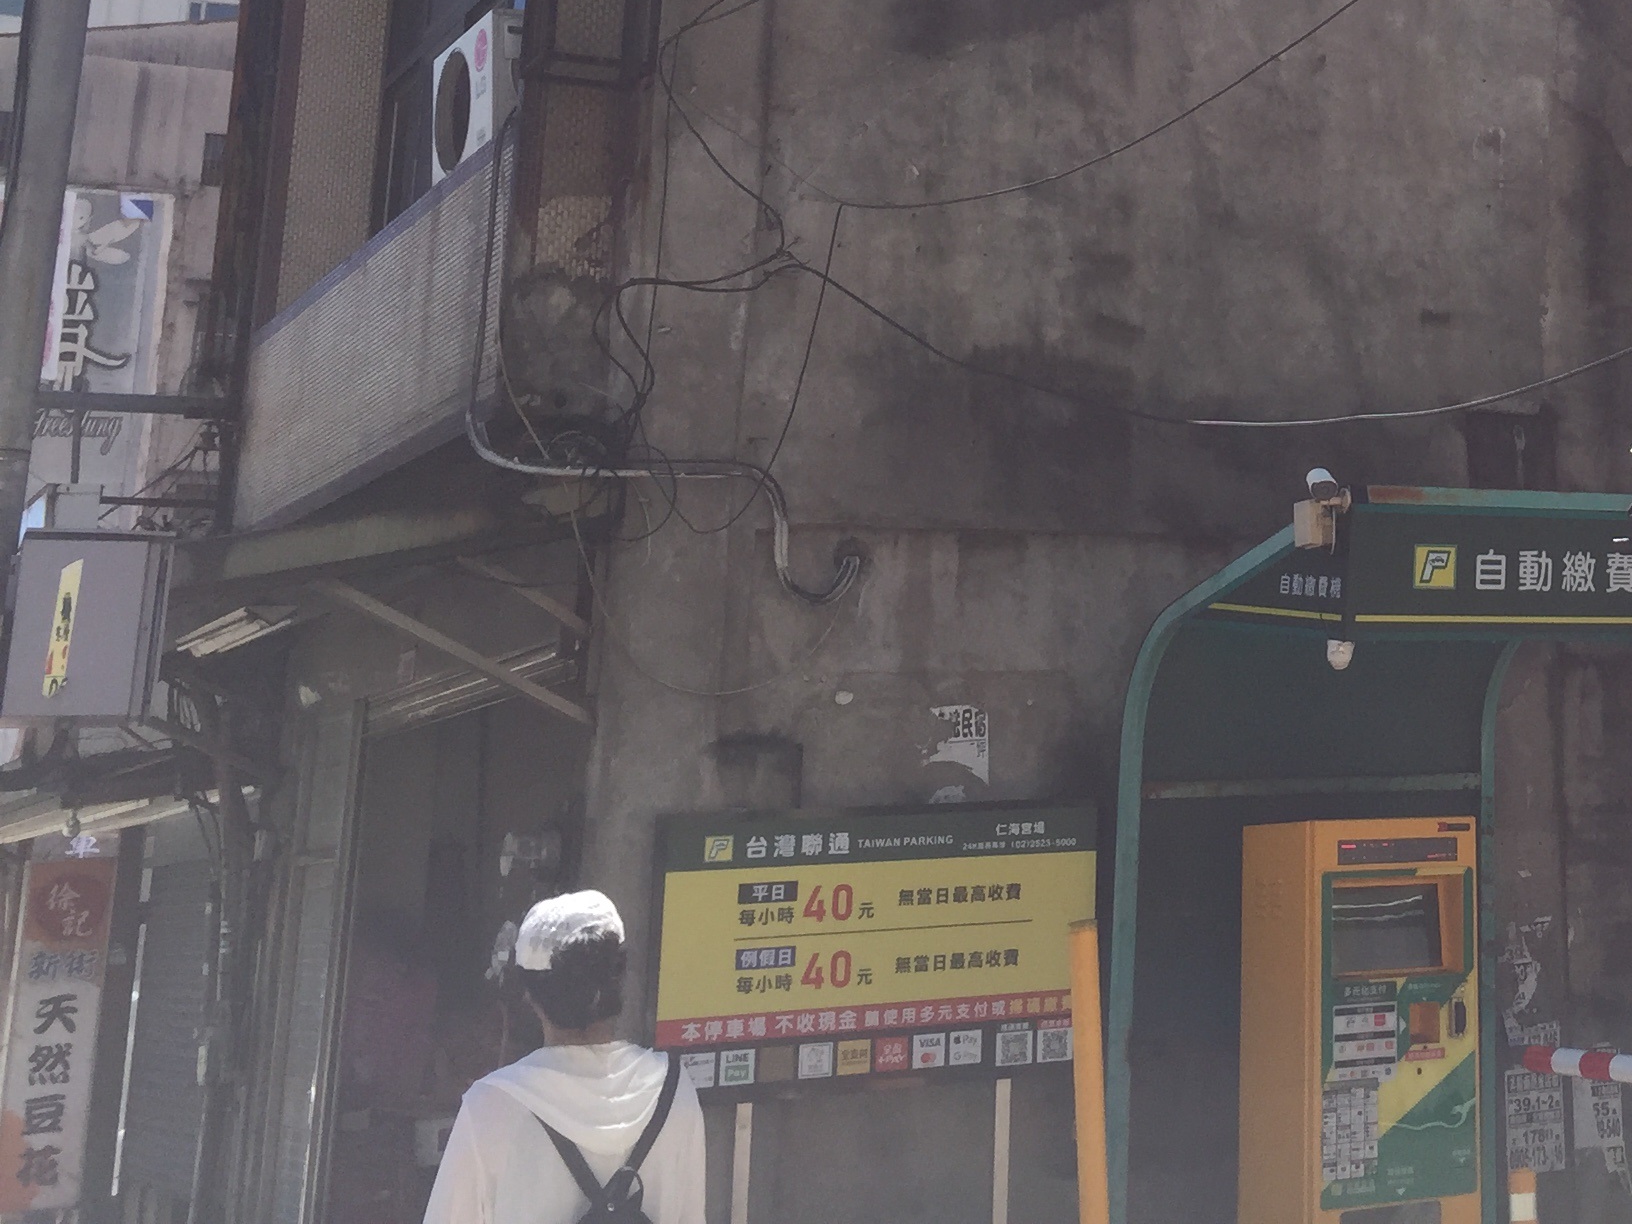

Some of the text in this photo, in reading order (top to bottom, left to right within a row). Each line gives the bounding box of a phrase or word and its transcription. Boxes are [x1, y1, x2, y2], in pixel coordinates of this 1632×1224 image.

[1280, 572, 1342, 599] 自動繳費機
[995, 821, 1046, 837] 仁海宮場
[745, 832, 851, 859] 台灣聯通
[857, 834, 953, 849] TAIWAN PARKING
[738, 883, 1022, 927] 每小時 40 元 無當日最高收費
[751, 884, 786, 902] 平日
[740, 948, 794, 969] 例假日
[736, 949, 1019, 995] 每小時 40 元 無當日最高收費
[681, 1016, 767, 1042] 本停車場
[775, 1009, 858, 1034] 不收現金
[918, 1037, 942, 1048] VISA
[725, 1052, 750, 1064] LINE
[17, 992, 79, 1188] 天然豆花
